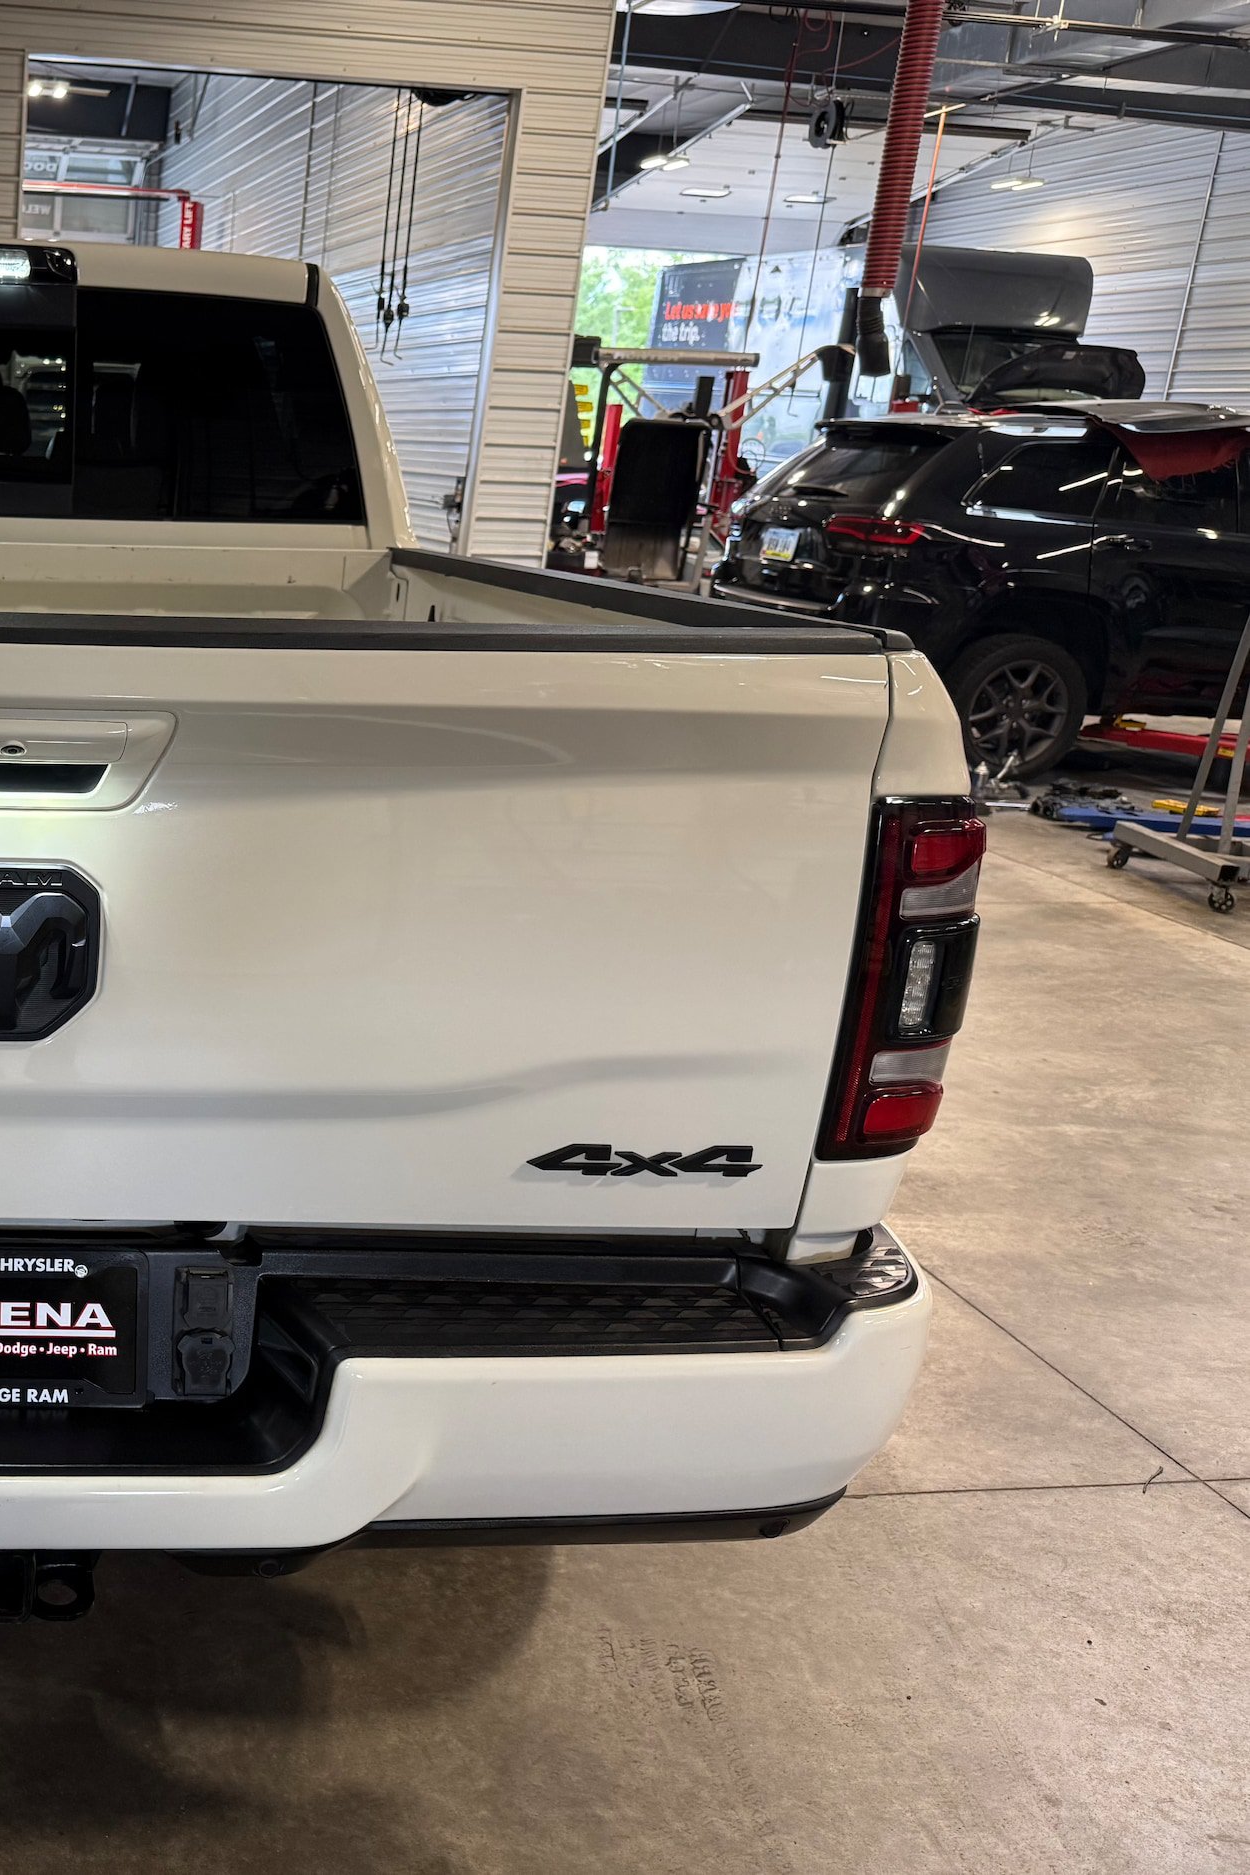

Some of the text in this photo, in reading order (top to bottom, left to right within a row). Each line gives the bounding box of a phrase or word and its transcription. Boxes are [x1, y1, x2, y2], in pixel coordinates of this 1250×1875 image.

[183, 201, 194, 225] LIFT
[664, 301, 682, 321] Let
[661, 321, 679, 342] the
[526, 1143, 763, 1177] 4x4
[46, 1343, 78, 1357] Jeep
[87, 1343, 117, 1356] Ram
[27, 1389, 69, 1403] RAM
